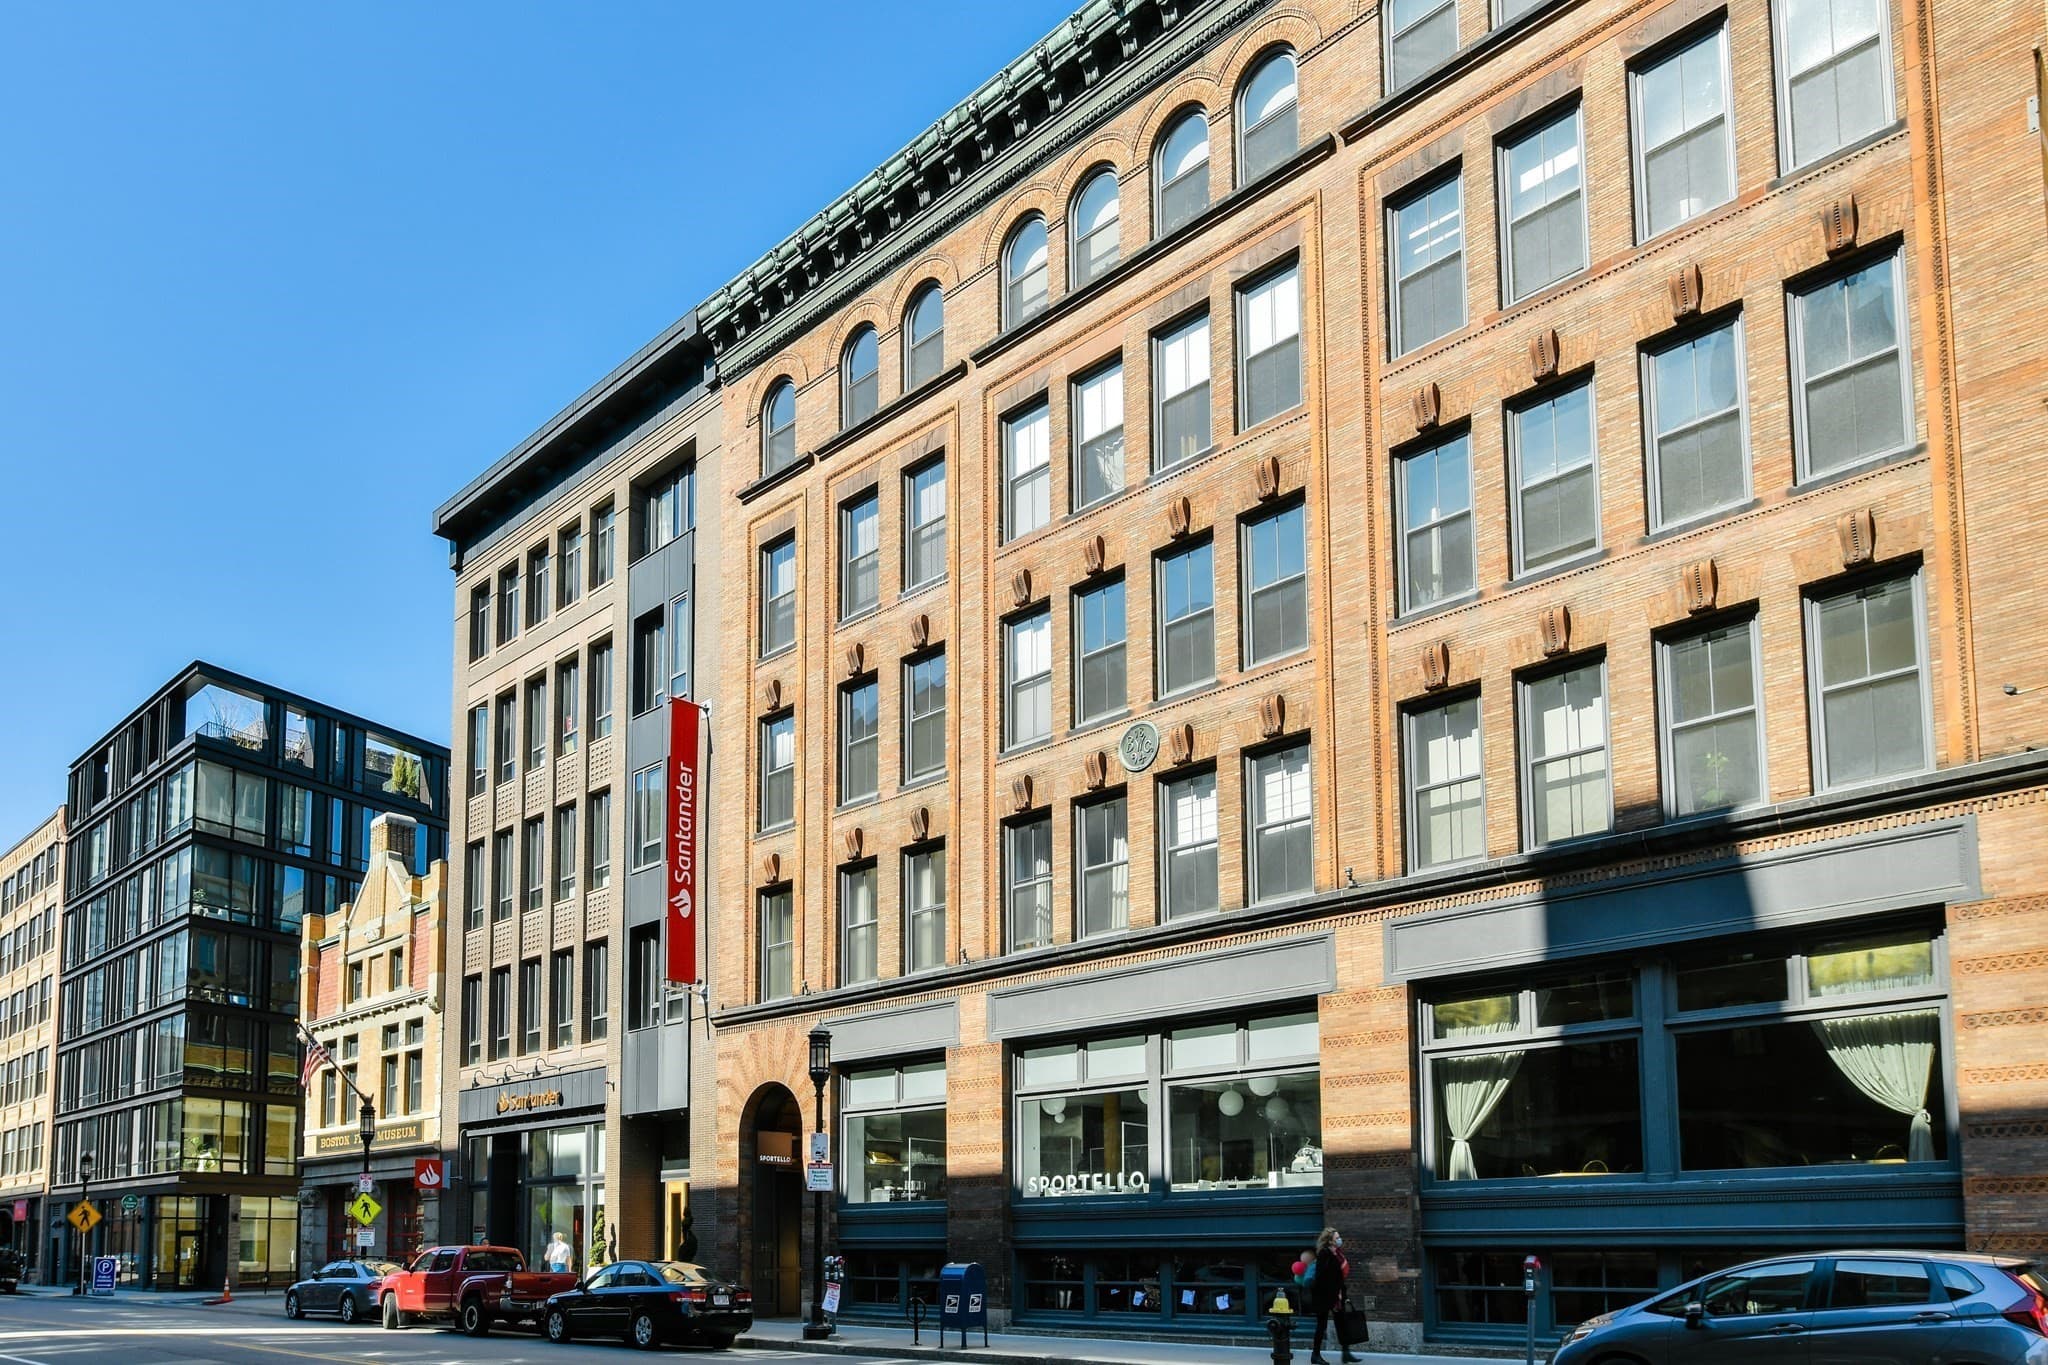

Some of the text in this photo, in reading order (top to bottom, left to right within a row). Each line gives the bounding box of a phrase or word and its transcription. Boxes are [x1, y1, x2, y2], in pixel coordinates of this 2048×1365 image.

[674, 761, 693, 885] Santander
[320, 1135, 350, 1149] BOSTON
[376, 1125, 417, 1142] MUSEUM
[759, 1154, 791, 1163] SPORTELLO
[1028, 1171, 1145, 1194] SPORTELLO
